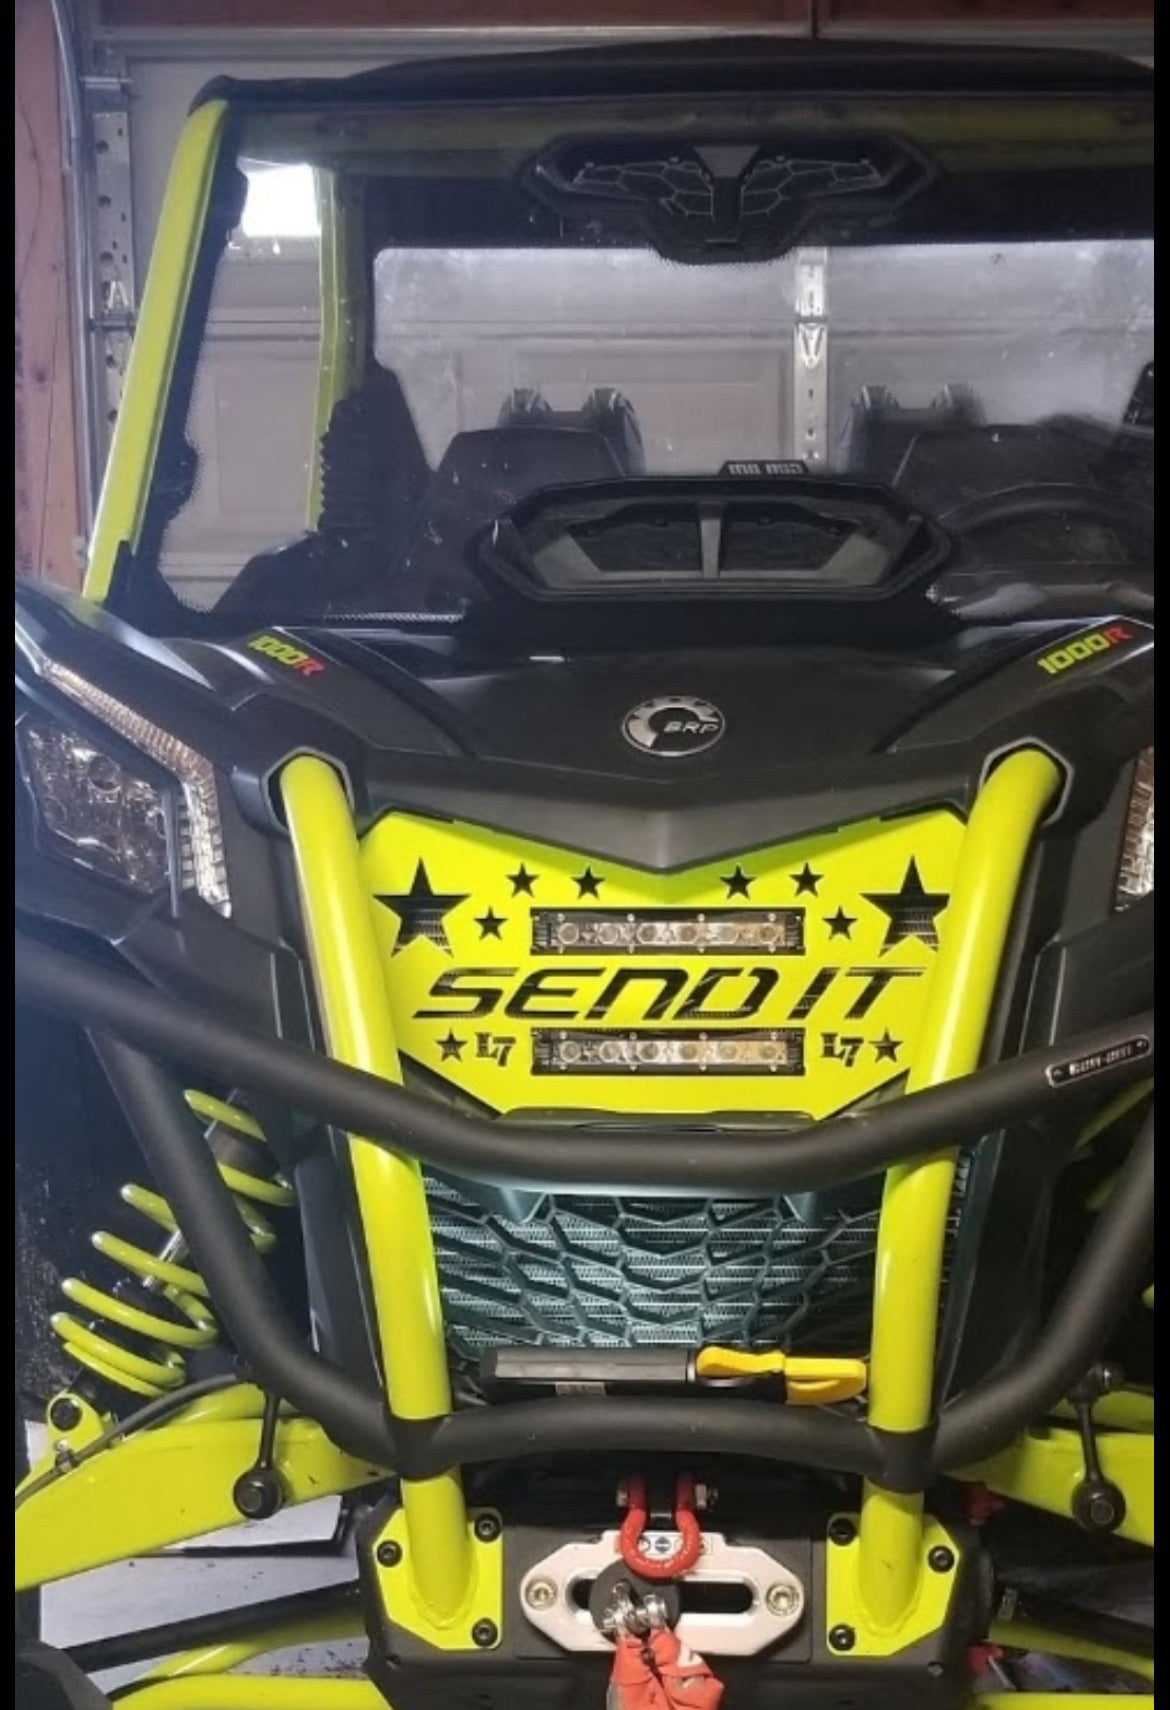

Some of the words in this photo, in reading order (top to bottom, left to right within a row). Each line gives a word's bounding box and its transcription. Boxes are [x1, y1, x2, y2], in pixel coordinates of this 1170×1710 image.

[249, 635, 325, 675] 1000R
[1037, 627, 1132, 674] 1000R
[664, 721, 719, 734] BRP
[413, 966, 780, 1020] SEND
[787, 967, 927, 1020] IT
[475, 1031, 516, 1067] L7
[820, 1031, 864, 1067] L7
